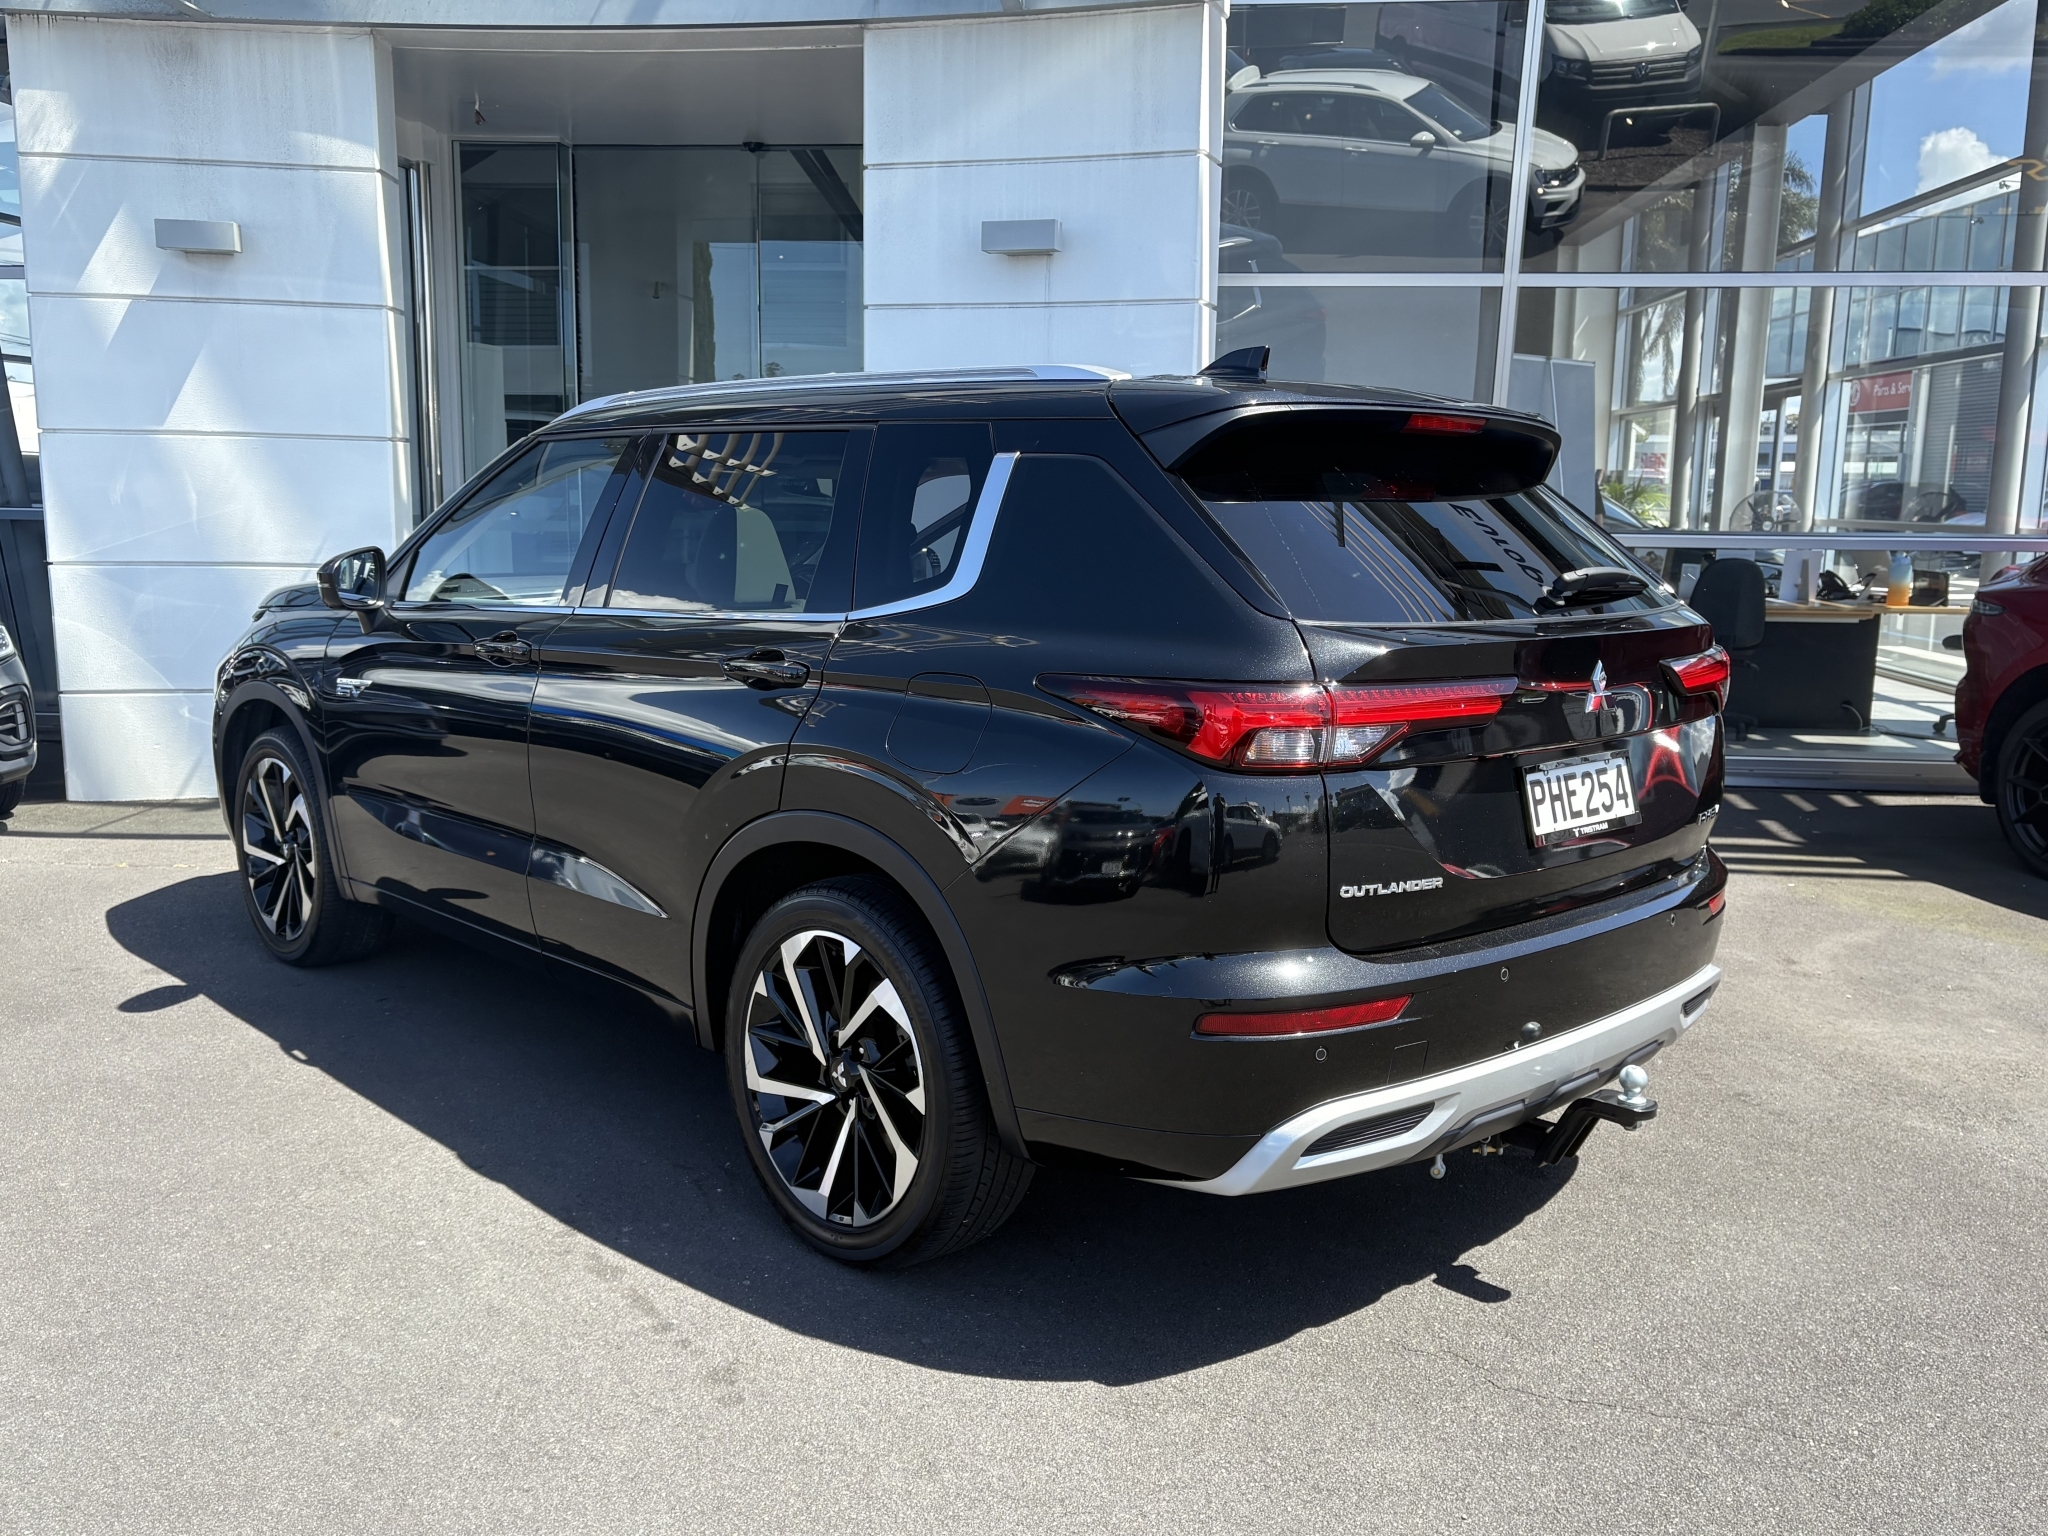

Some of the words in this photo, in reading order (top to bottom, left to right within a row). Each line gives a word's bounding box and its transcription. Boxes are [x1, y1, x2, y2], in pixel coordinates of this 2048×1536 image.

[1529, 764, 1630, 828] PHE254
[1580, 821, 1609, 835] TRISTRAM
[1339, 876, 1444, 899] OUTLANDER
